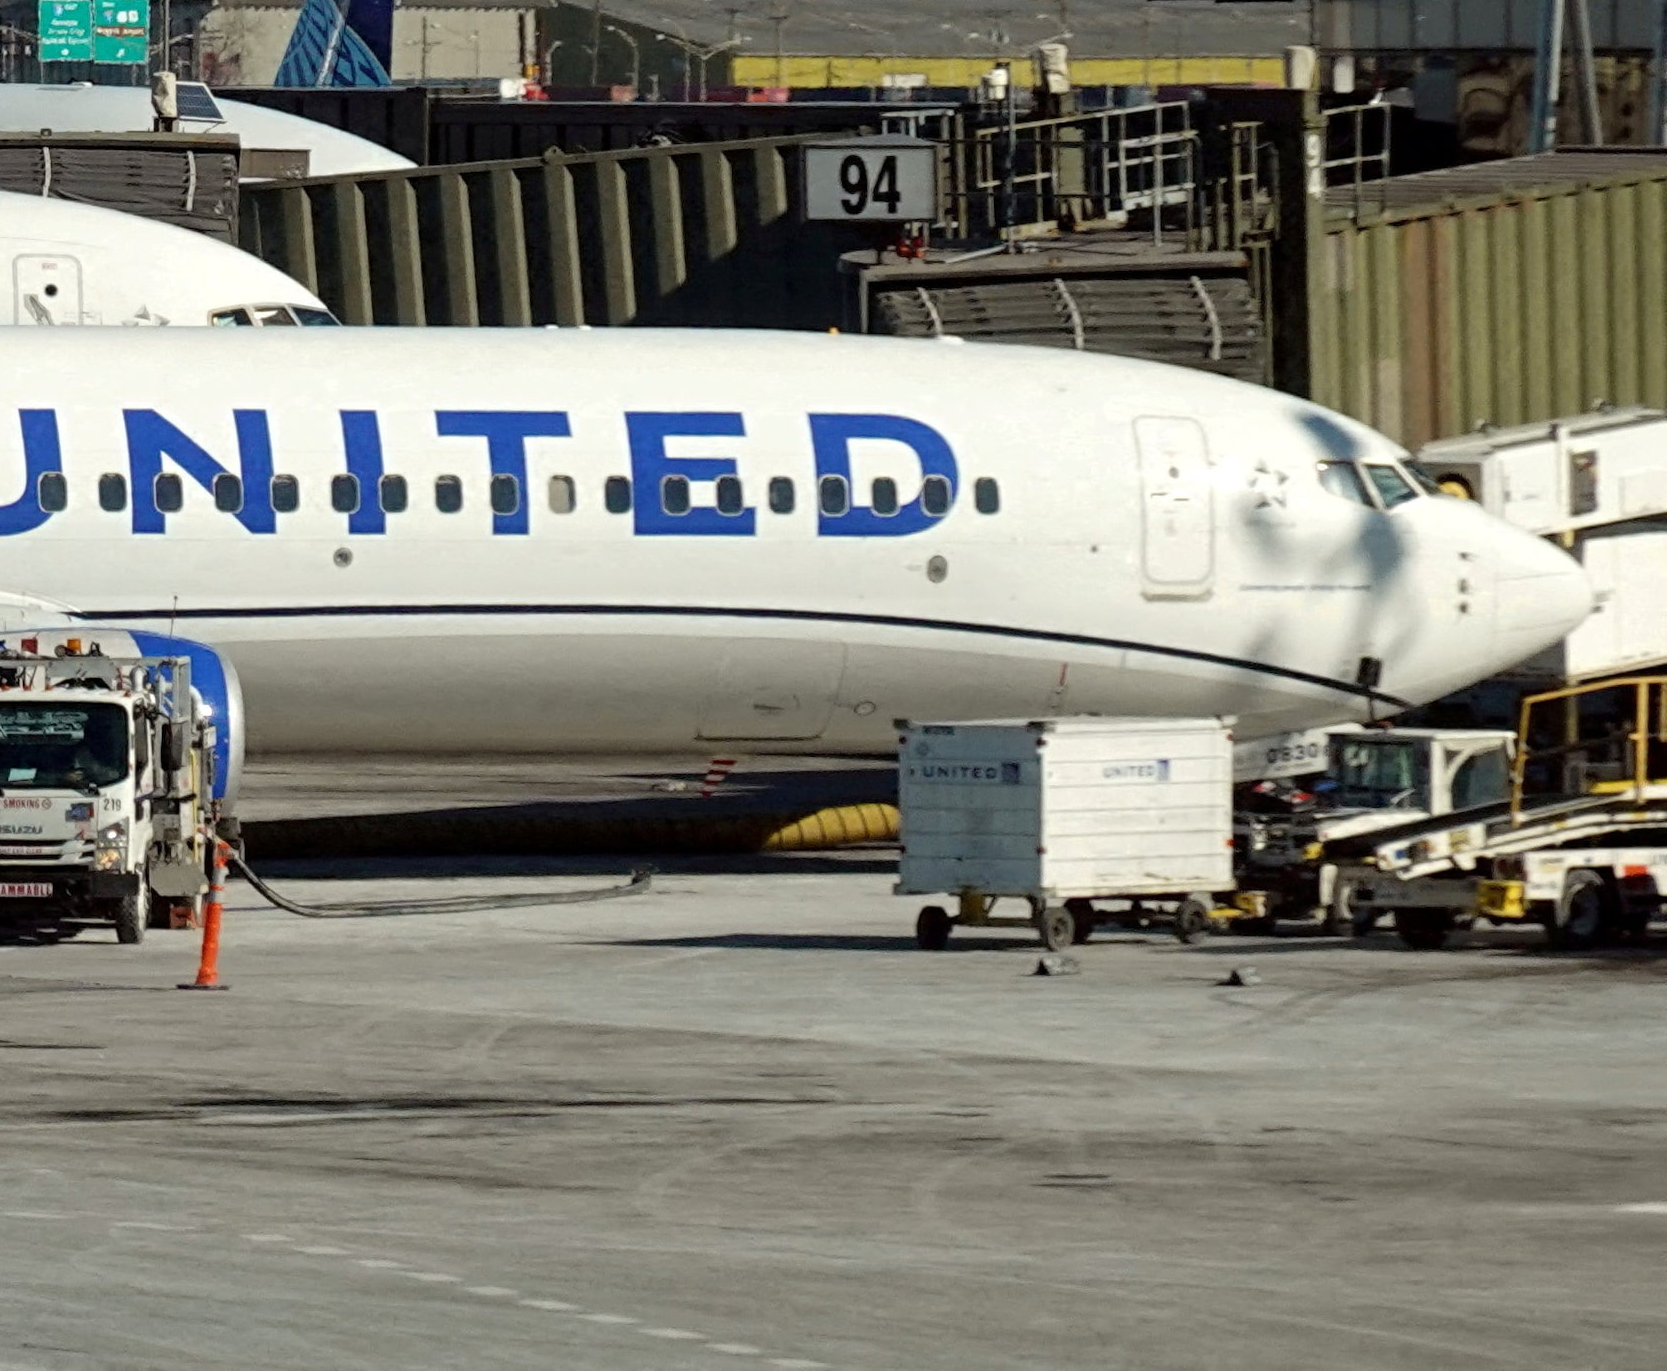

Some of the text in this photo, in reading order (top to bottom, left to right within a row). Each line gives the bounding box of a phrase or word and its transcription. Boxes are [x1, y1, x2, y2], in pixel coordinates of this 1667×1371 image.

[840, 154, 901, 215] 94
[923, 766, 997, 779] UNITED
[3, 799, 40, 808] SMOKING
[103, 798, 122, 811] 219
